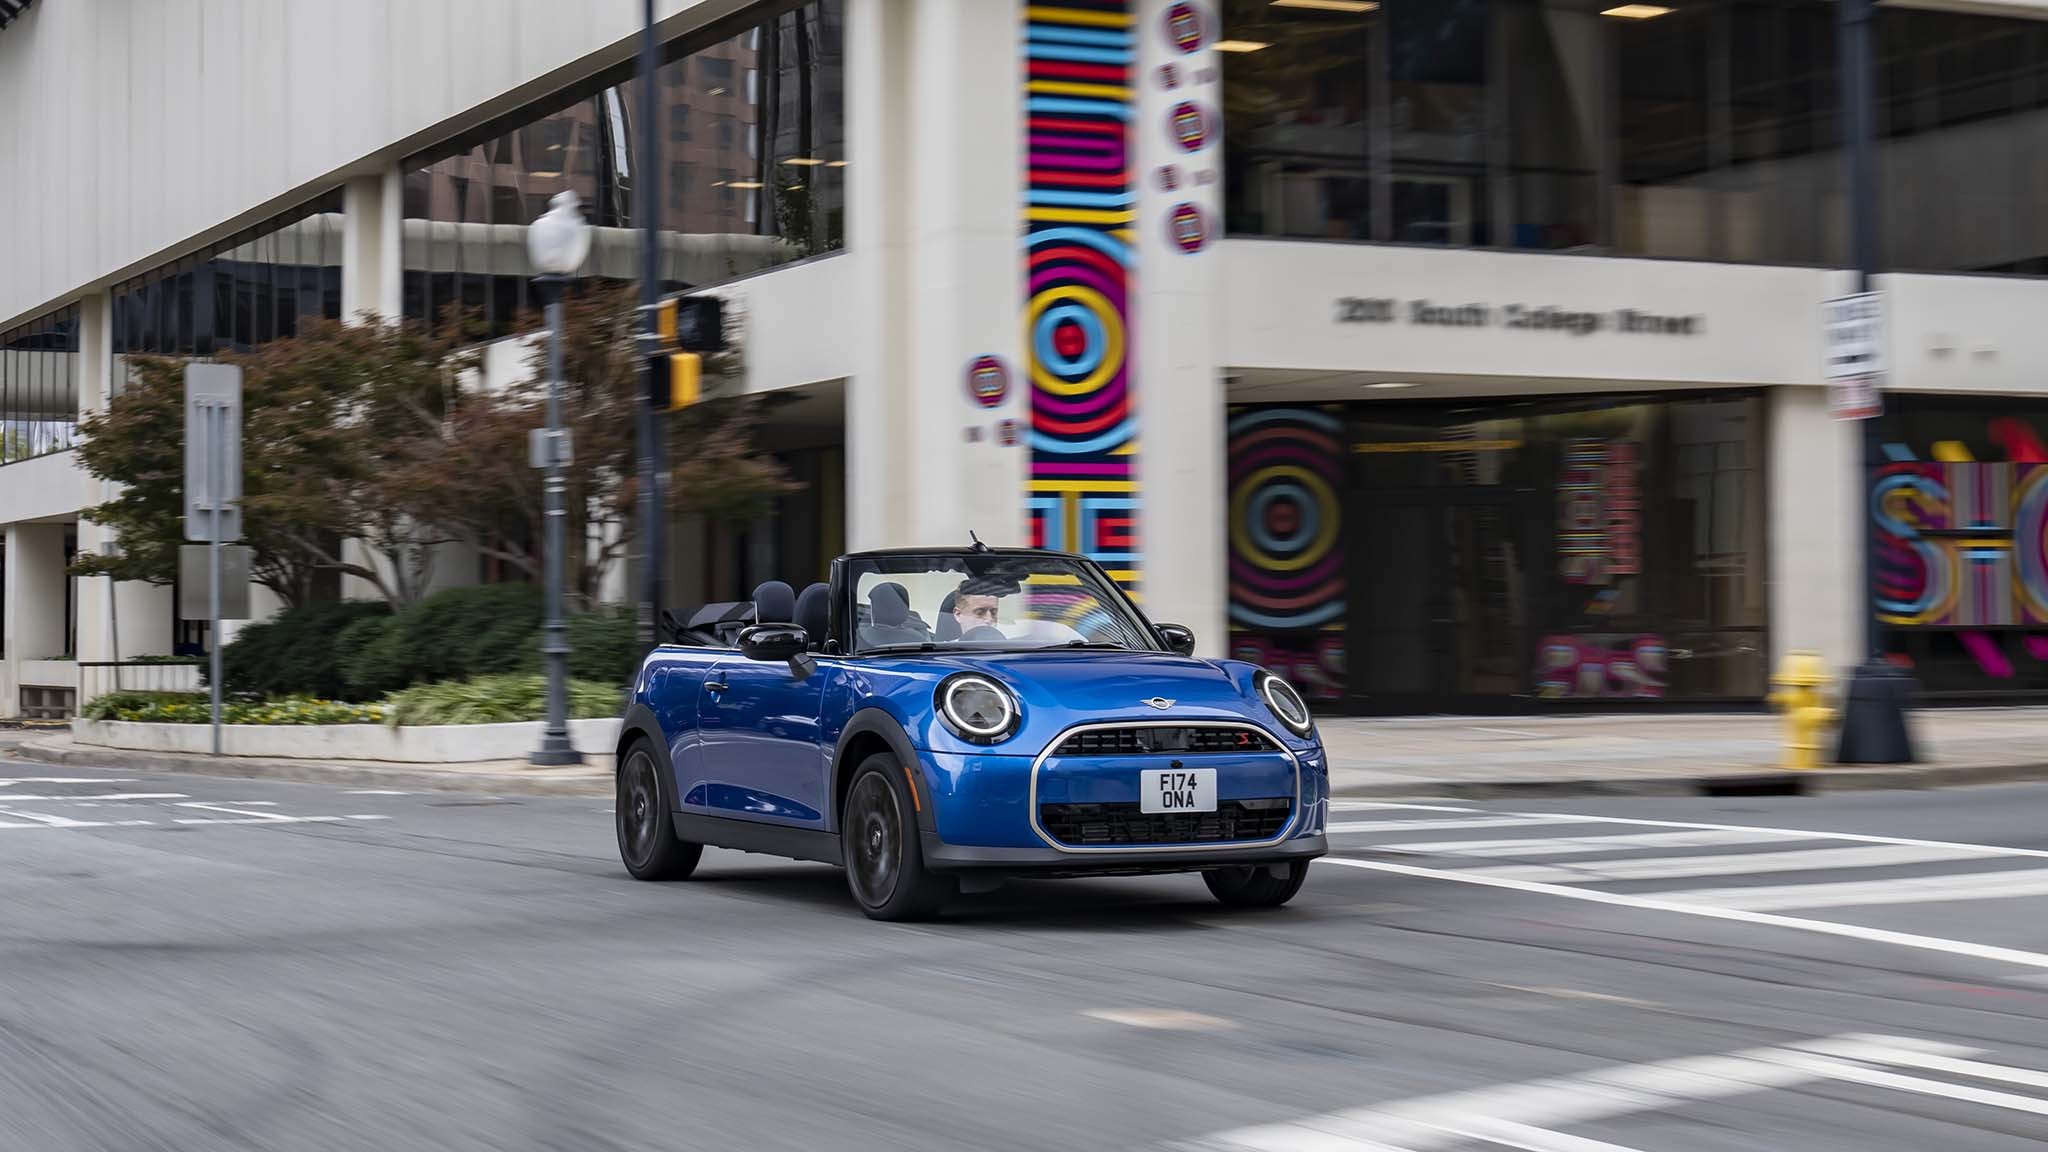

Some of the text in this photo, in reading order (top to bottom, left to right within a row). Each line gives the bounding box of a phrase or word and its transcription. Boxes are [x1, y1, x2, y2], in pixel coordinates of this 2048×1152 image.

[1407, 299, 1489, 327] South
[1503, 303, 1600, 337] College
[1614, 308, 1703, 335] Street
[1160, 773, 1197, 791] F174
[1163, 790, 1195, 808] ONA
